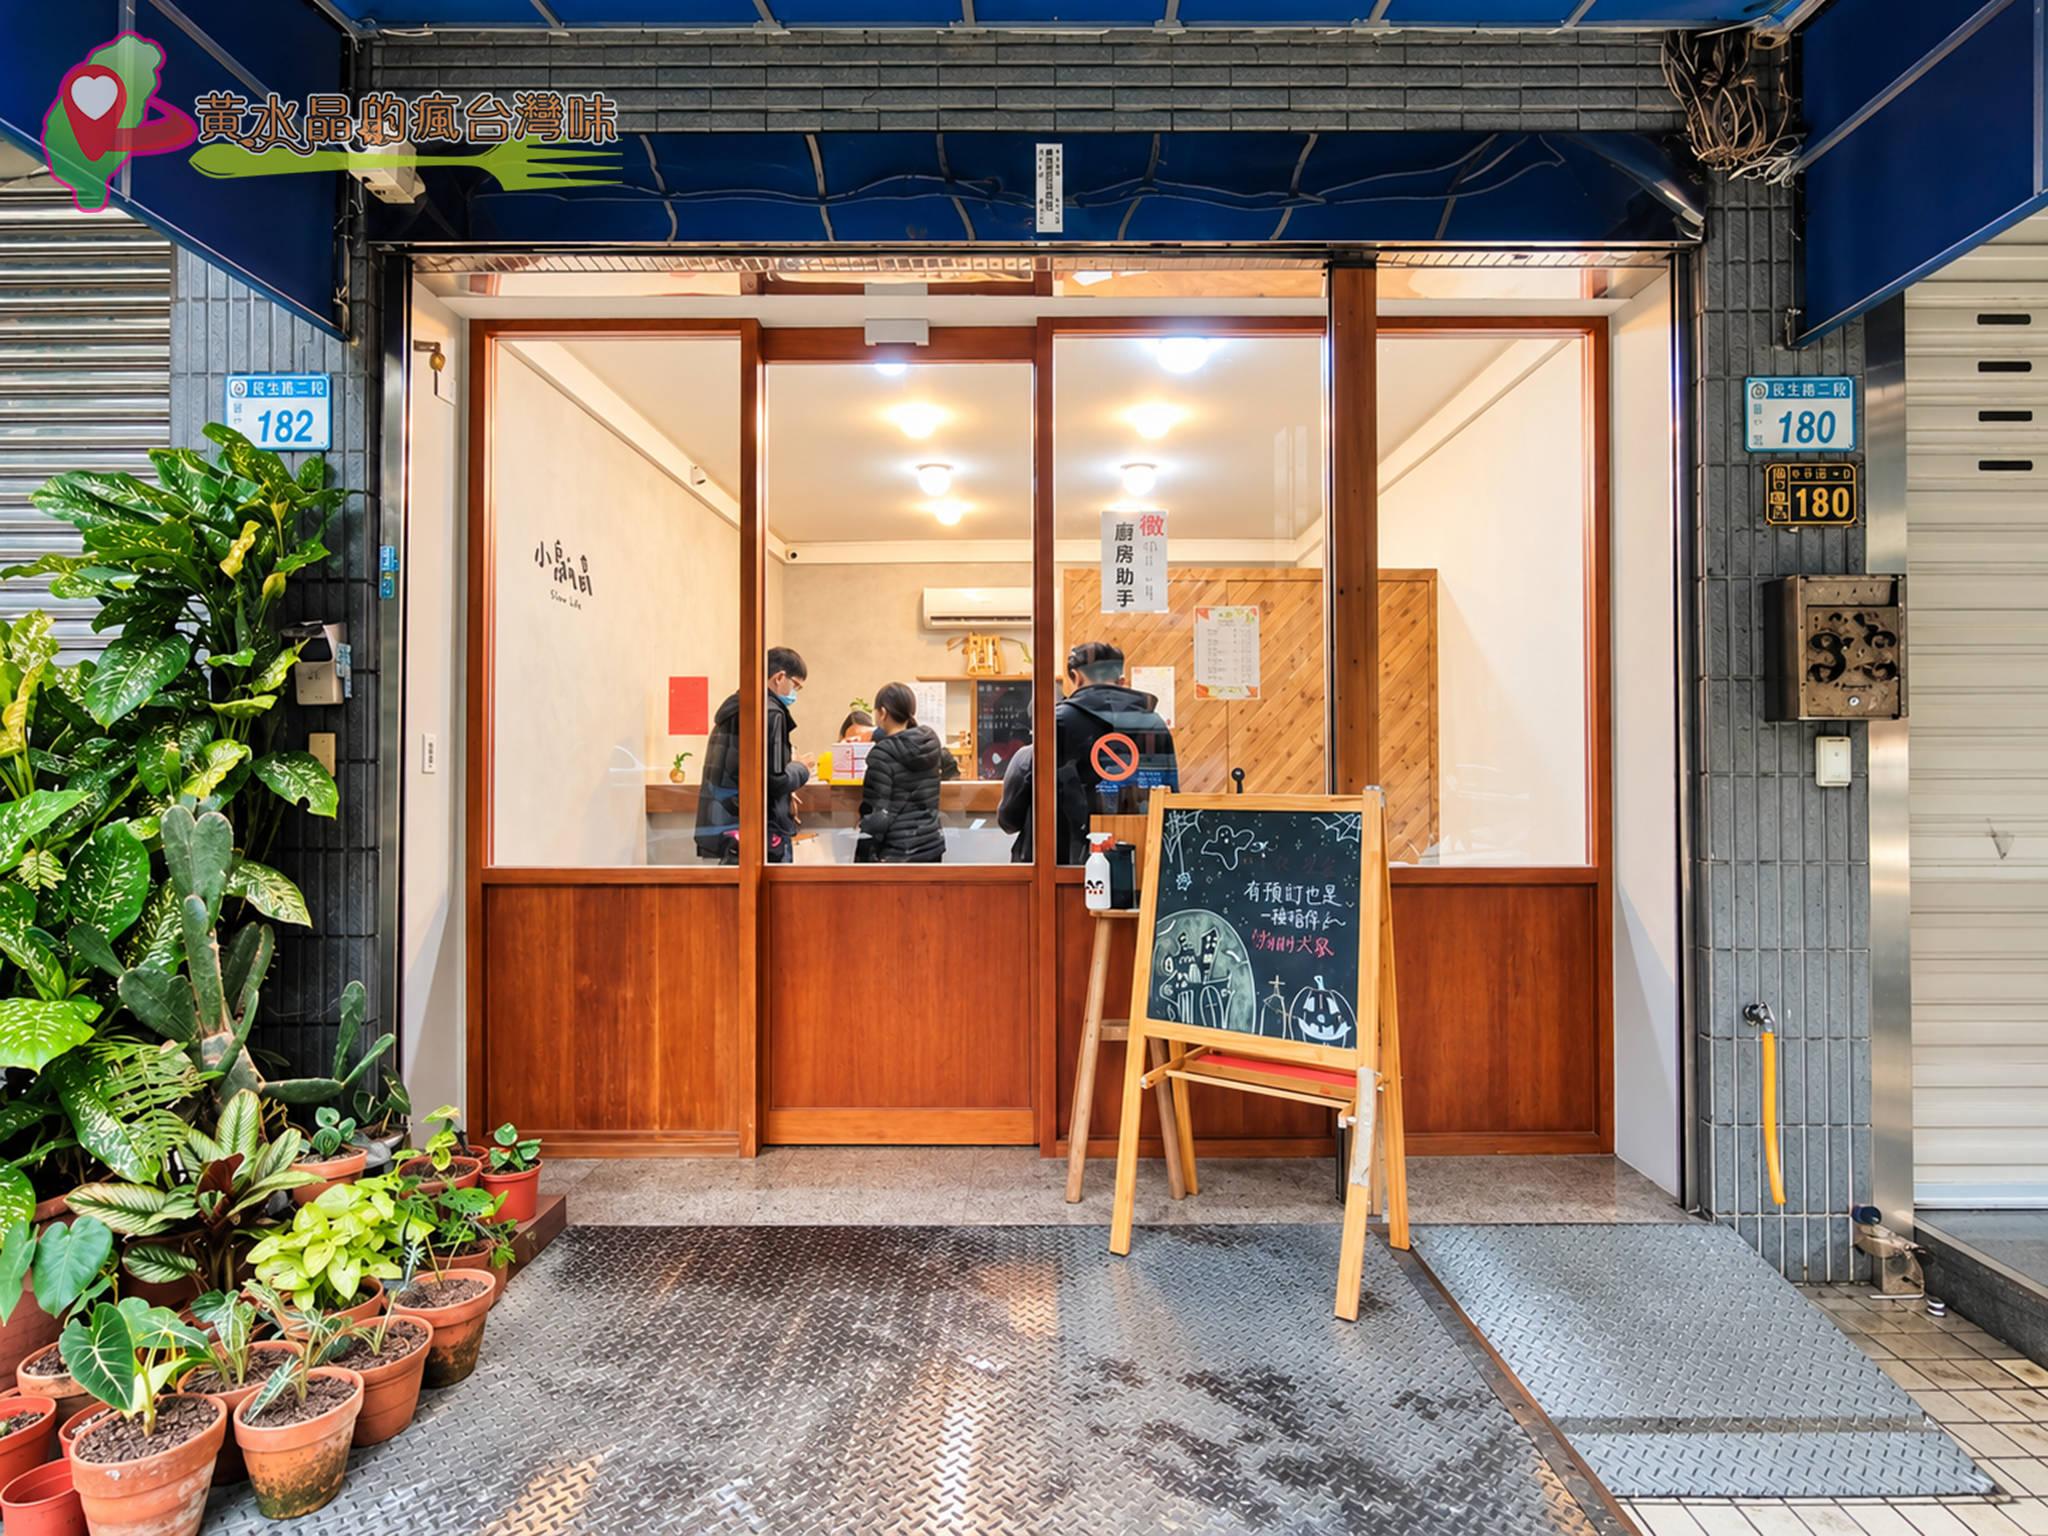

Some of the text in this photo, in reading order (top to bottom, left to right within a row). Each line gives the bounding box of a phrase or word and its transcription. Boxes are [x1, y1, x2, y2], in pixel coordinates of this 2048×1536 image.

[1773, 382, 1847, 397] 民生路二段
[258, 409, 314, 443] 182
[1779, 410, 1836, 444] 180
[1796, 487, 1850, 518] 180
[1114, 521, 1135, 608] 廚房助手
